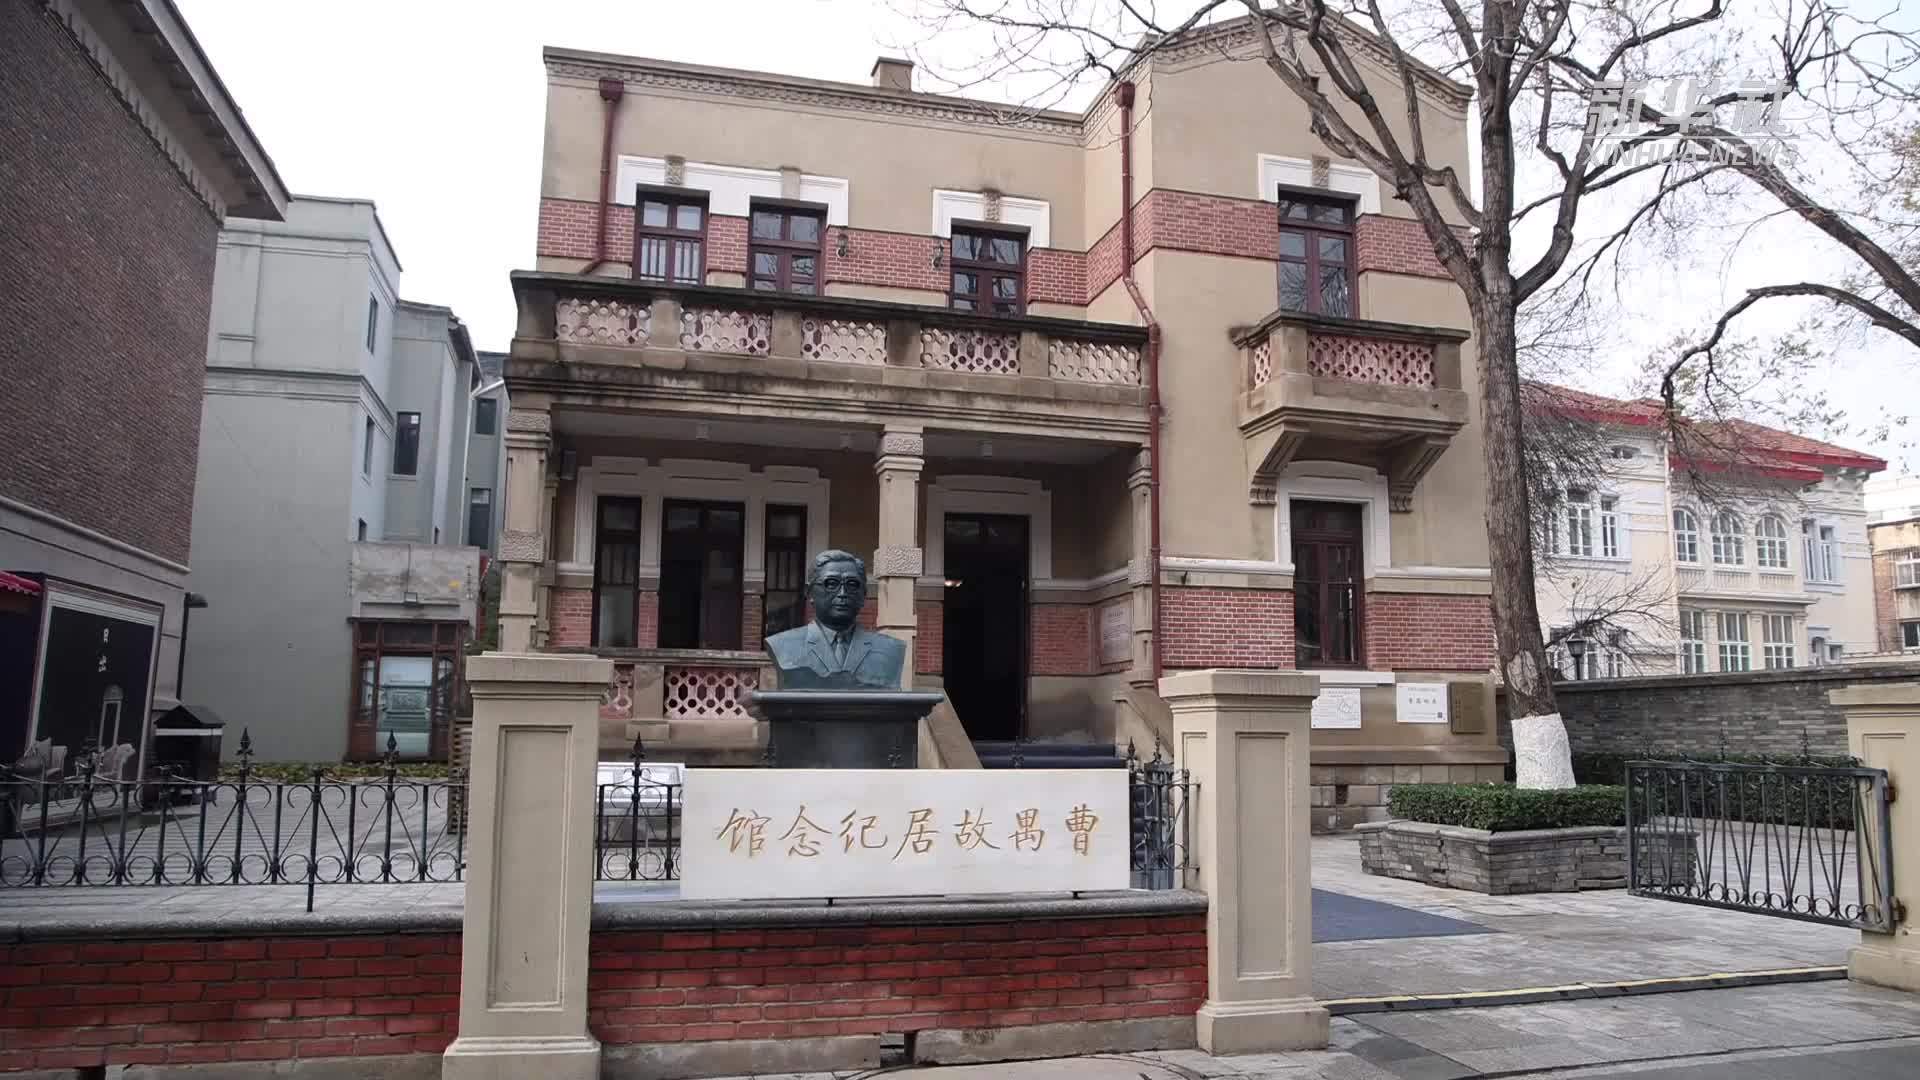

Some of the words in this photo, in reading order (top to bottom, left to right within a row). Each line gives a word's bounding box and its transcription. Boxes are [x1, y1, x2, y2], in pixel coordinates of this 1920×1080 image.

[715, 804, 1100, 861] 曹禺故居纪念馆
